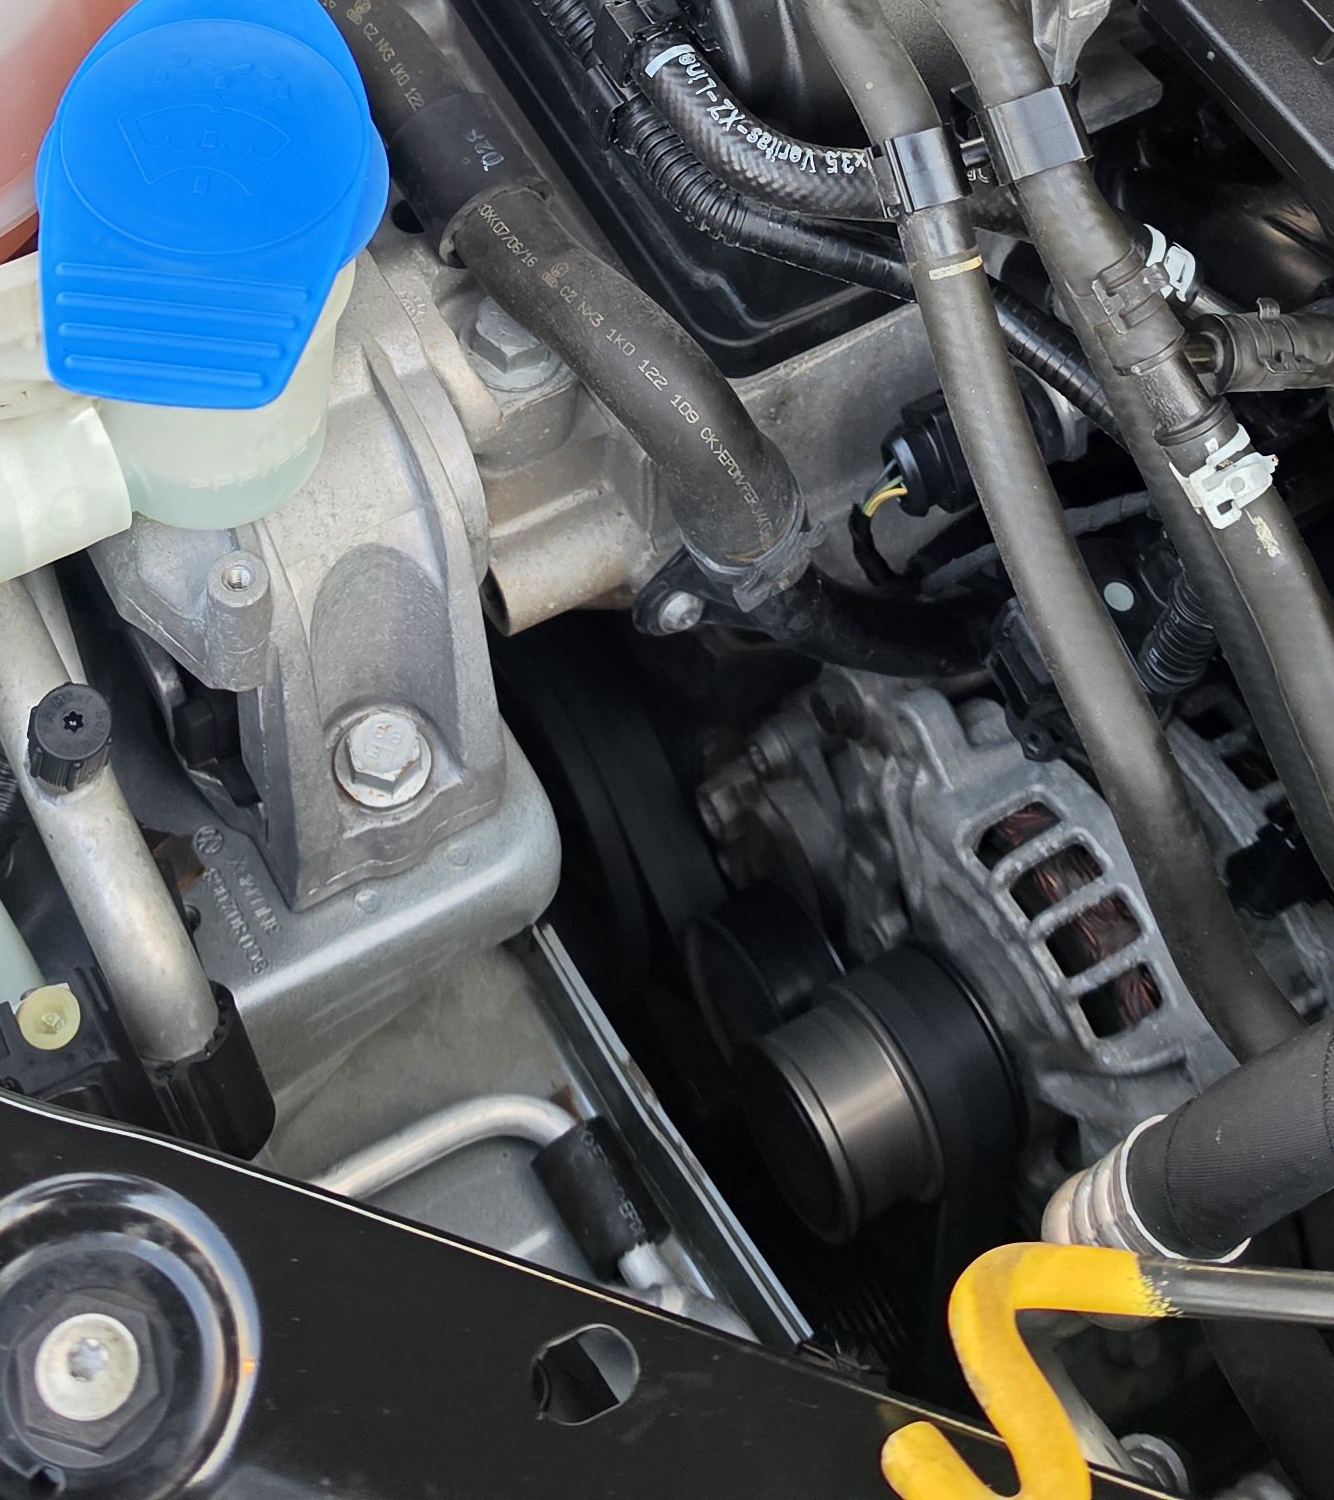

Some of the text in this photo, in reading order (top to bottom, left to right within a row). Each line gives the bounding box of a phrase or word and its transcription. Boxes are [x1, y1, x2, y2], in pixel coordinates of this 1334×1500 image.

[404, 87, 425, 113] 122
[559, 285, 578, 304] CZ
[577, 301, 605, 328] NX3
[637, 359, 669, 391] 122
[669, 394, 700, 424] 109
